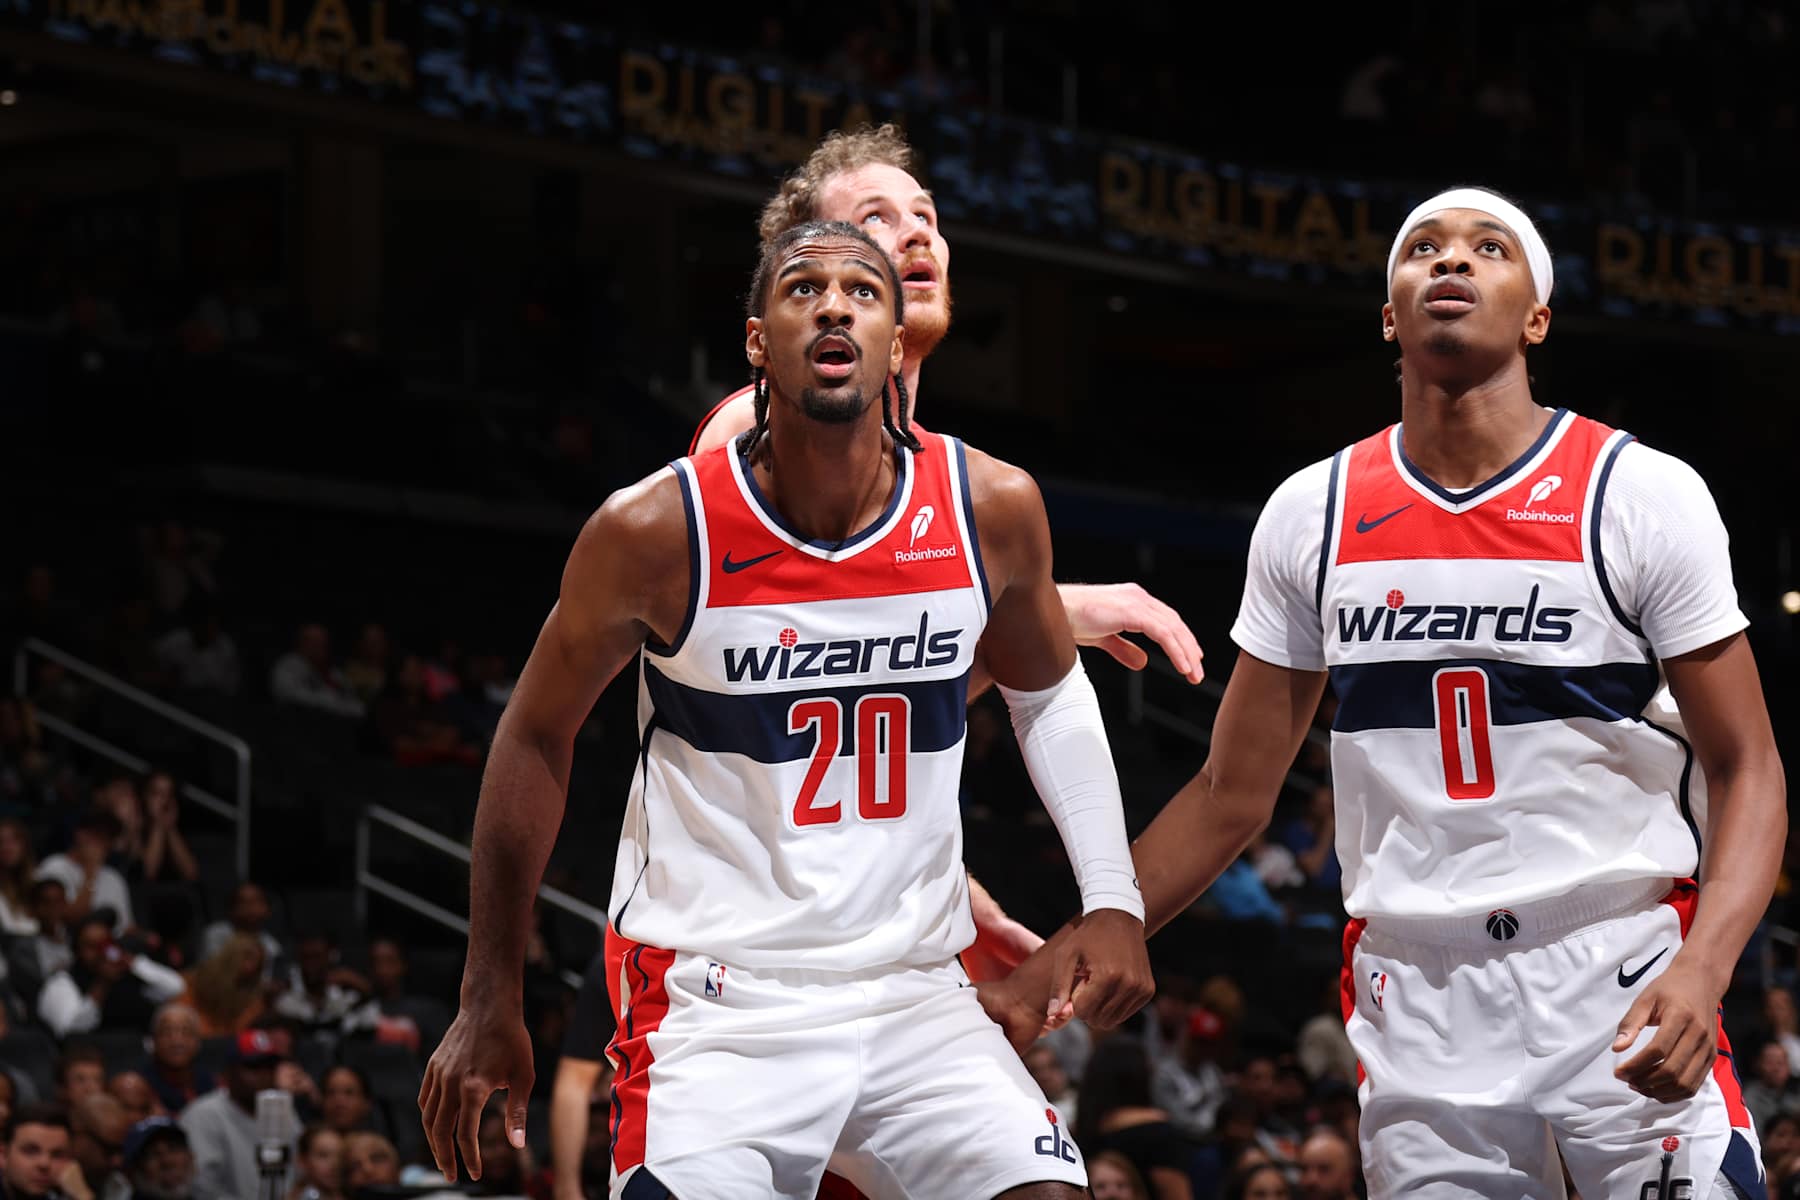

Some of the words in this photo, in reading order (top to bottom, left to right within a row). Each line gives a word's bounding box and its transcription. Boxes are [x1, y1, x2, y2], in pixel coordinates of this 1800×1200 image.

[1100, 152, 1390, 244] DIGITAL
[1596, 224, 1800, 300] DIGIT
[1506, 508, 1575, 524] Robinhood
[895, 544, 957, 563] Robinhood
[723, 610, 965, 683] wizards
[1338, 583, 1581, 644] wizards
[788, 694, 911, 829] 20
[1433, 667, 1496, 801] 0
[1034, 1120, 1077, 1165] dc
